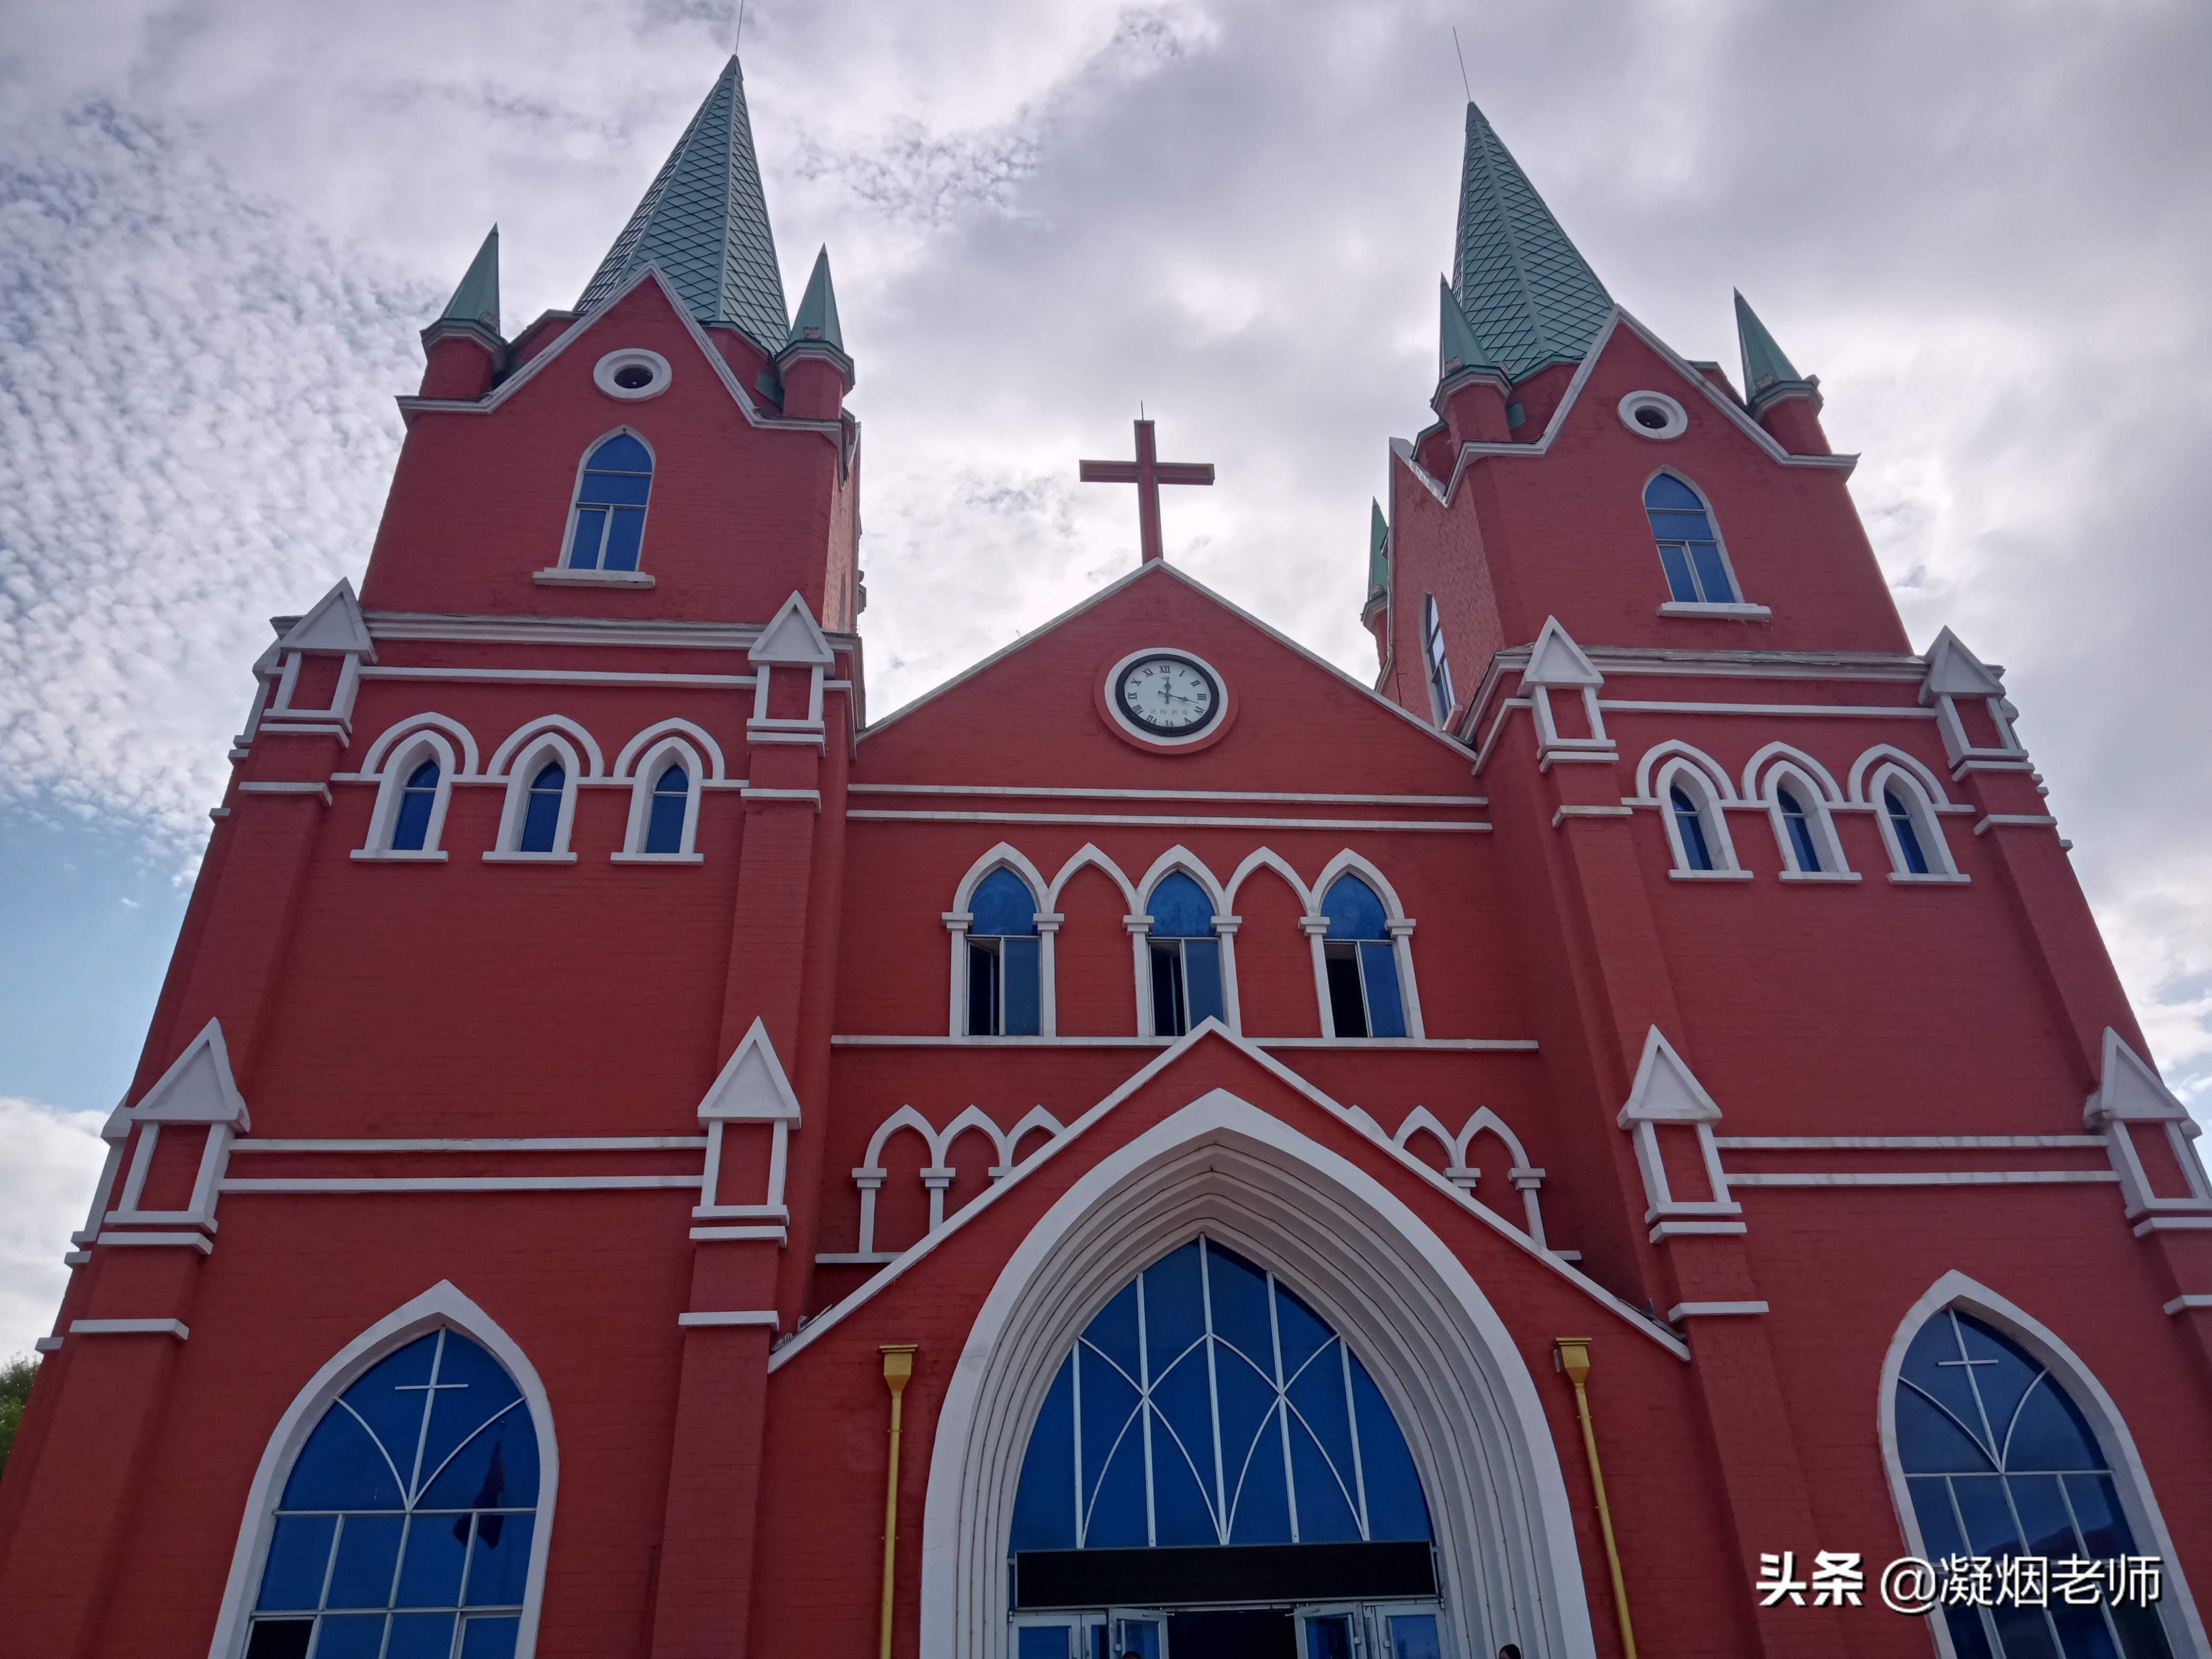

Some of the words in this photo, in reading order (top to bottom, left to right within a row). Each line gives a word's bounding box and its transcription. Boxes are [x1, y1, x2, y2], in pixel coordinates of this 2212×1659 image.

[1142, 668, 1154, 677] XI
[1130, 678, 1142, 687] X
[1132, 704, 1144, 715] VIII
[1194, 706, 1204, 715] IV
